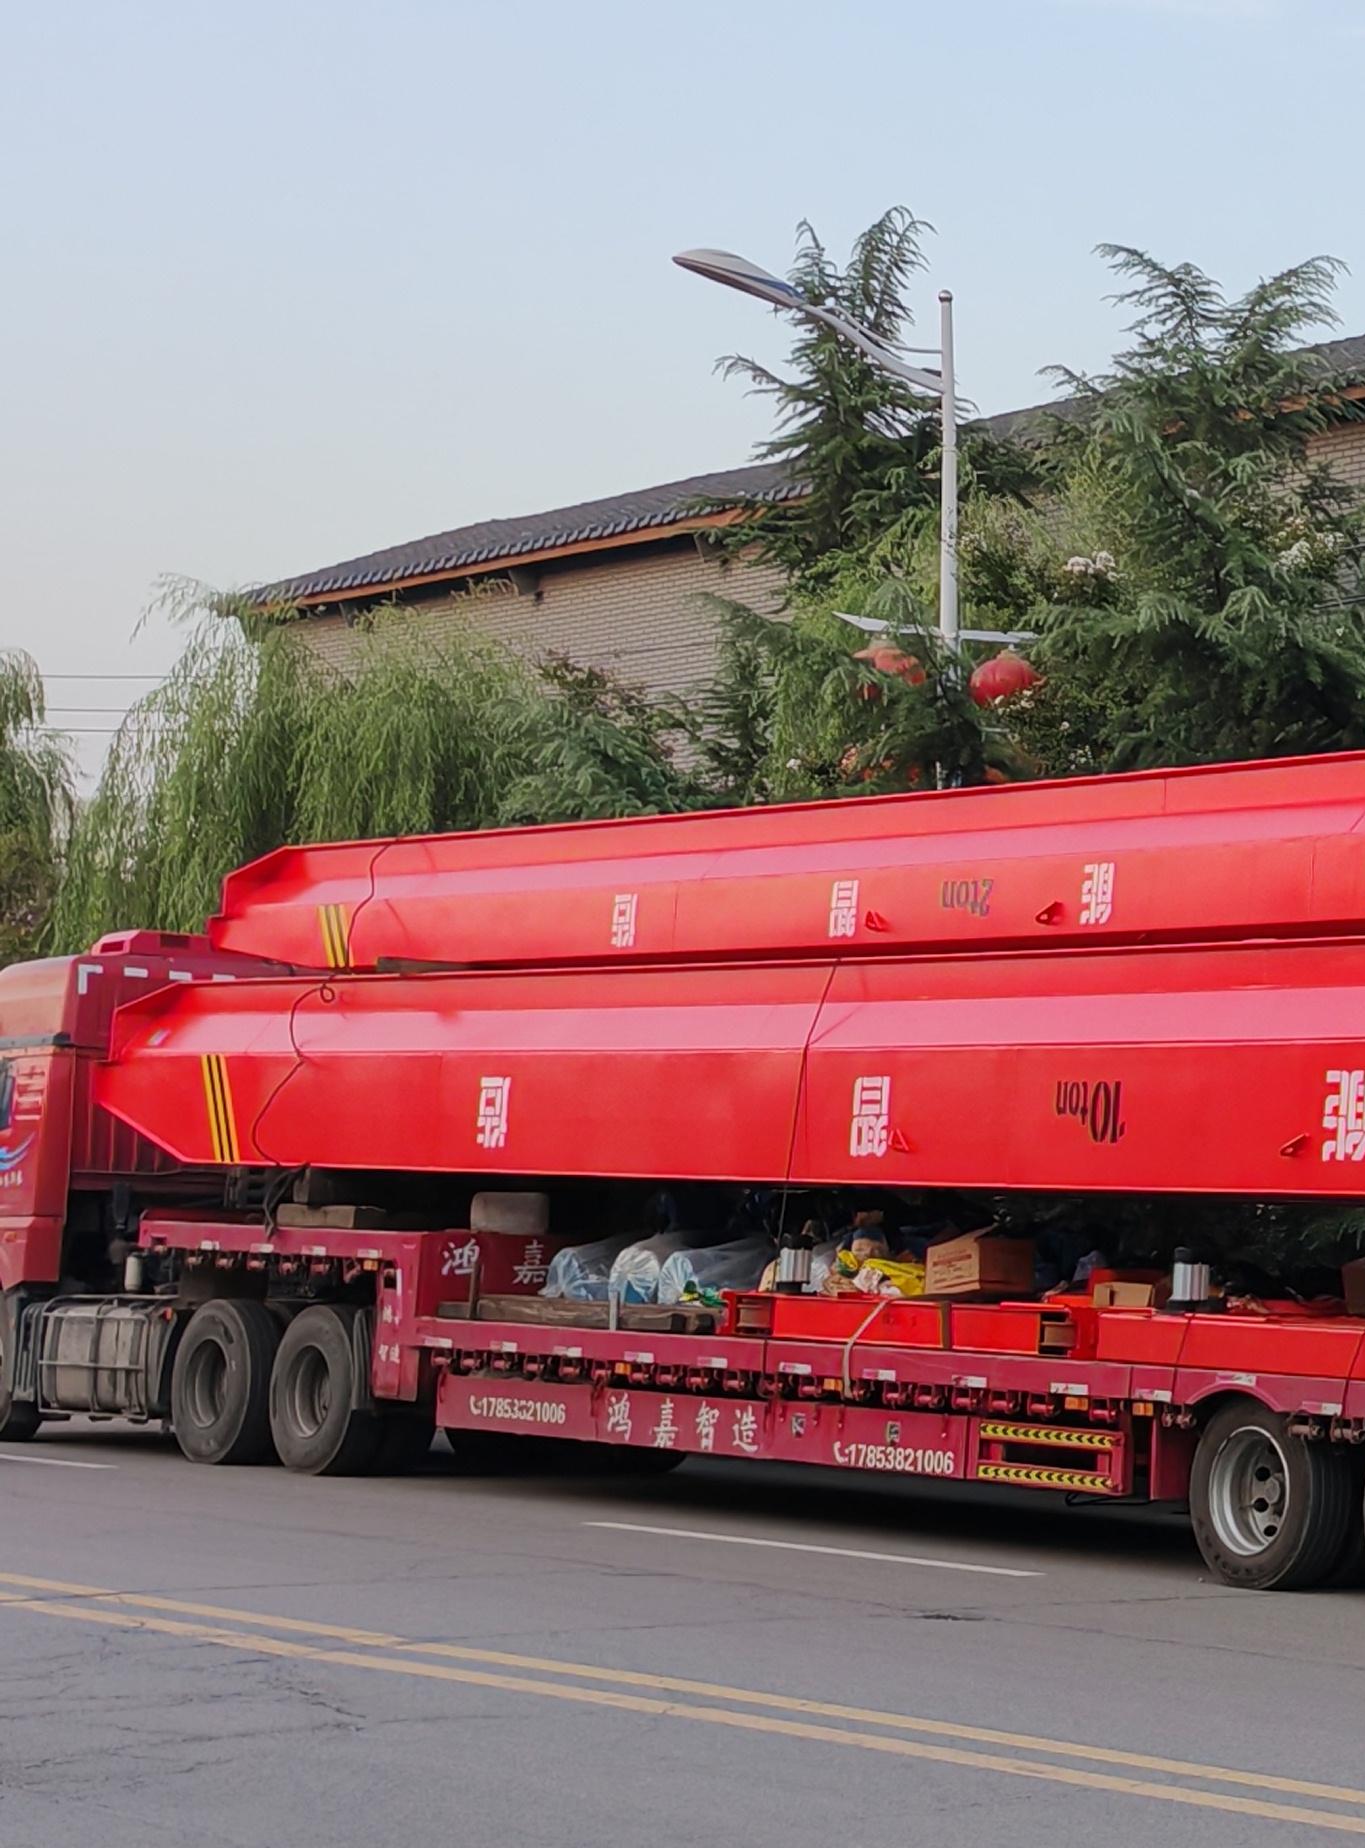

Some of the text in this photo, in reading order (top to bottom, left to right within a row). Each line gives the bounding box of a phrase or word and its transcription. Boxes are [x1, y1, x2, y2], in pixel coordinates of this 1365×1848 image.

[941, 878, 993, 917] 2ton
[1080, 862, 1115, 925] 能
[1056, 1080, 1125, 1143] 10ton
